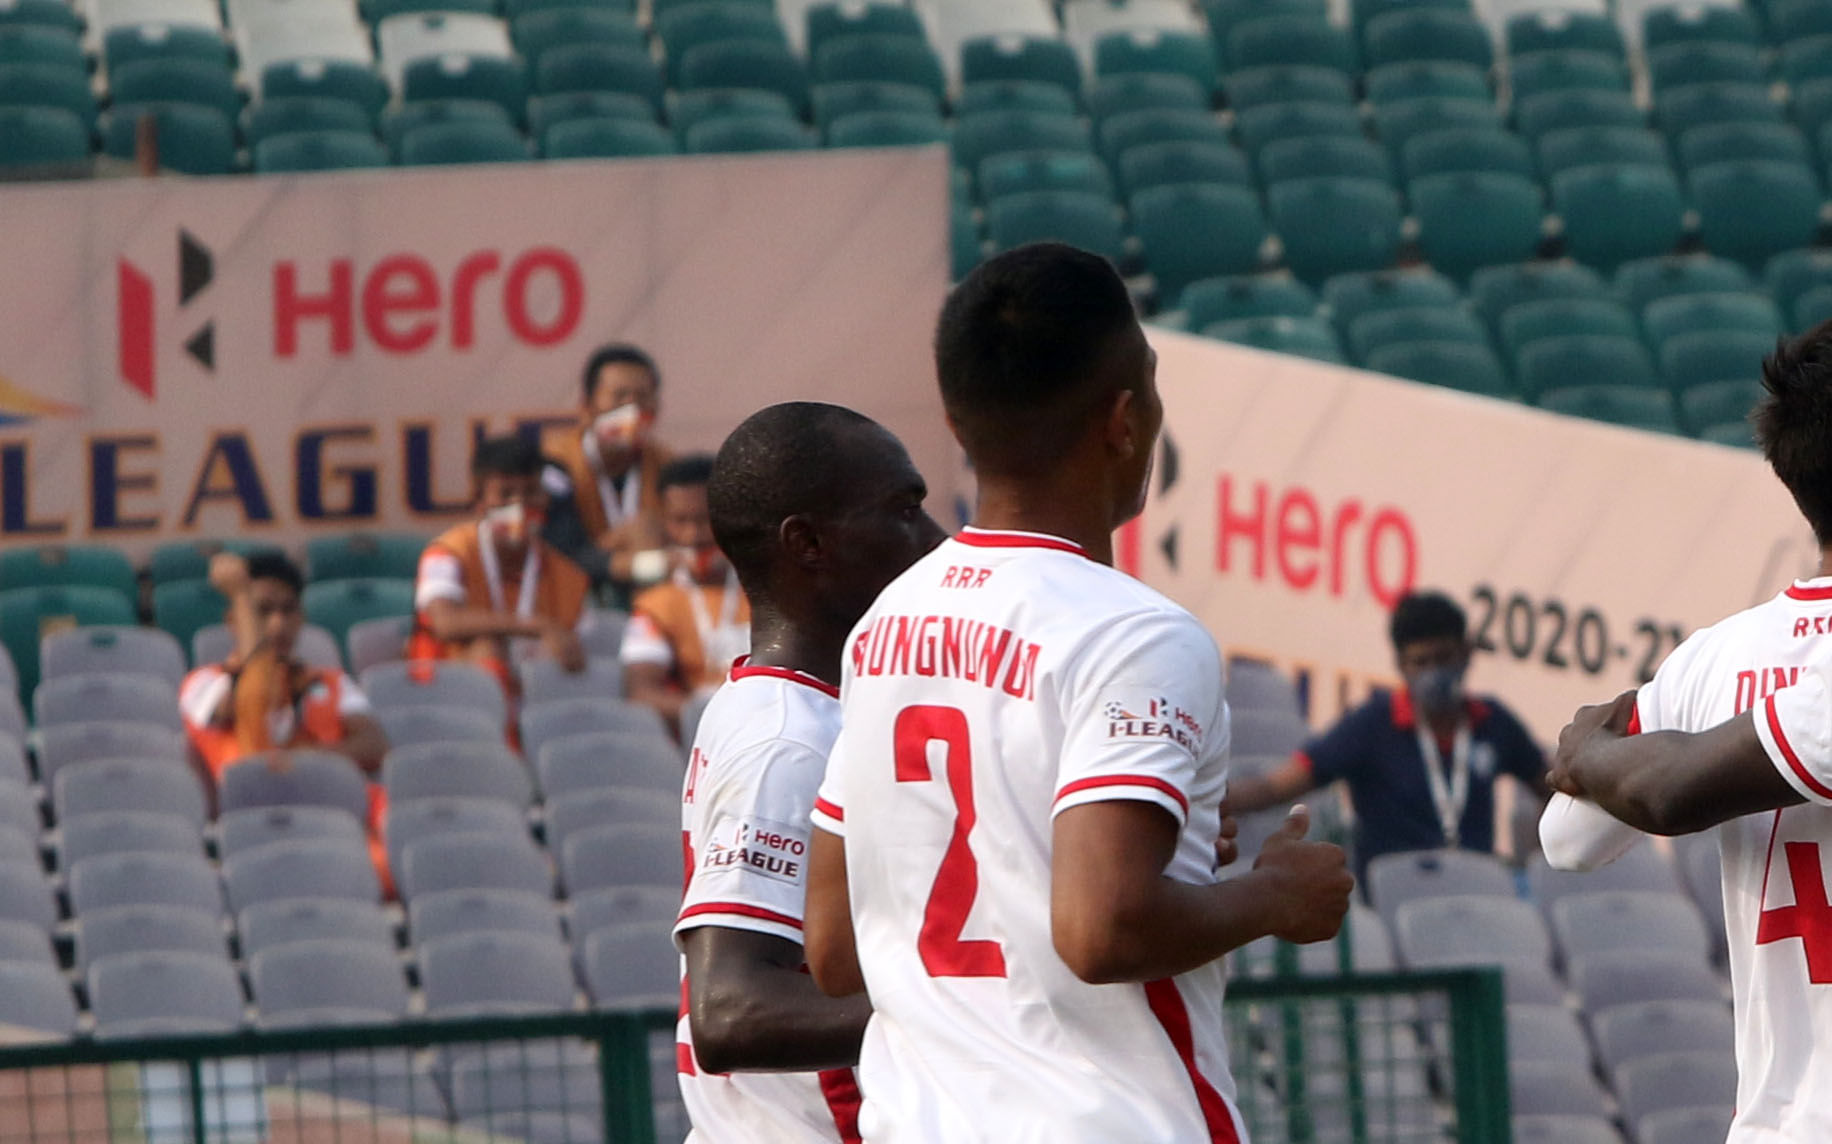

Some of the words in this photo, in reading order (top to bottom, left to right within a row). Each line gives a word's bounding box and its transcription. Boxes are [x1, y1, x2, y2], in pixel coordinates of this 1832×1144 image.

[272, 246, 585, 360] Hero
[0, 414, 582, 538] LEAGU
[940, 566, 992, 589] RRR
[1214, 472, 1420, 612] Hero
[1473, 583, 1682, 684] 2020-2
[755, 829, 805, 857] Hero
[894, 704, 1008, 978] 2
